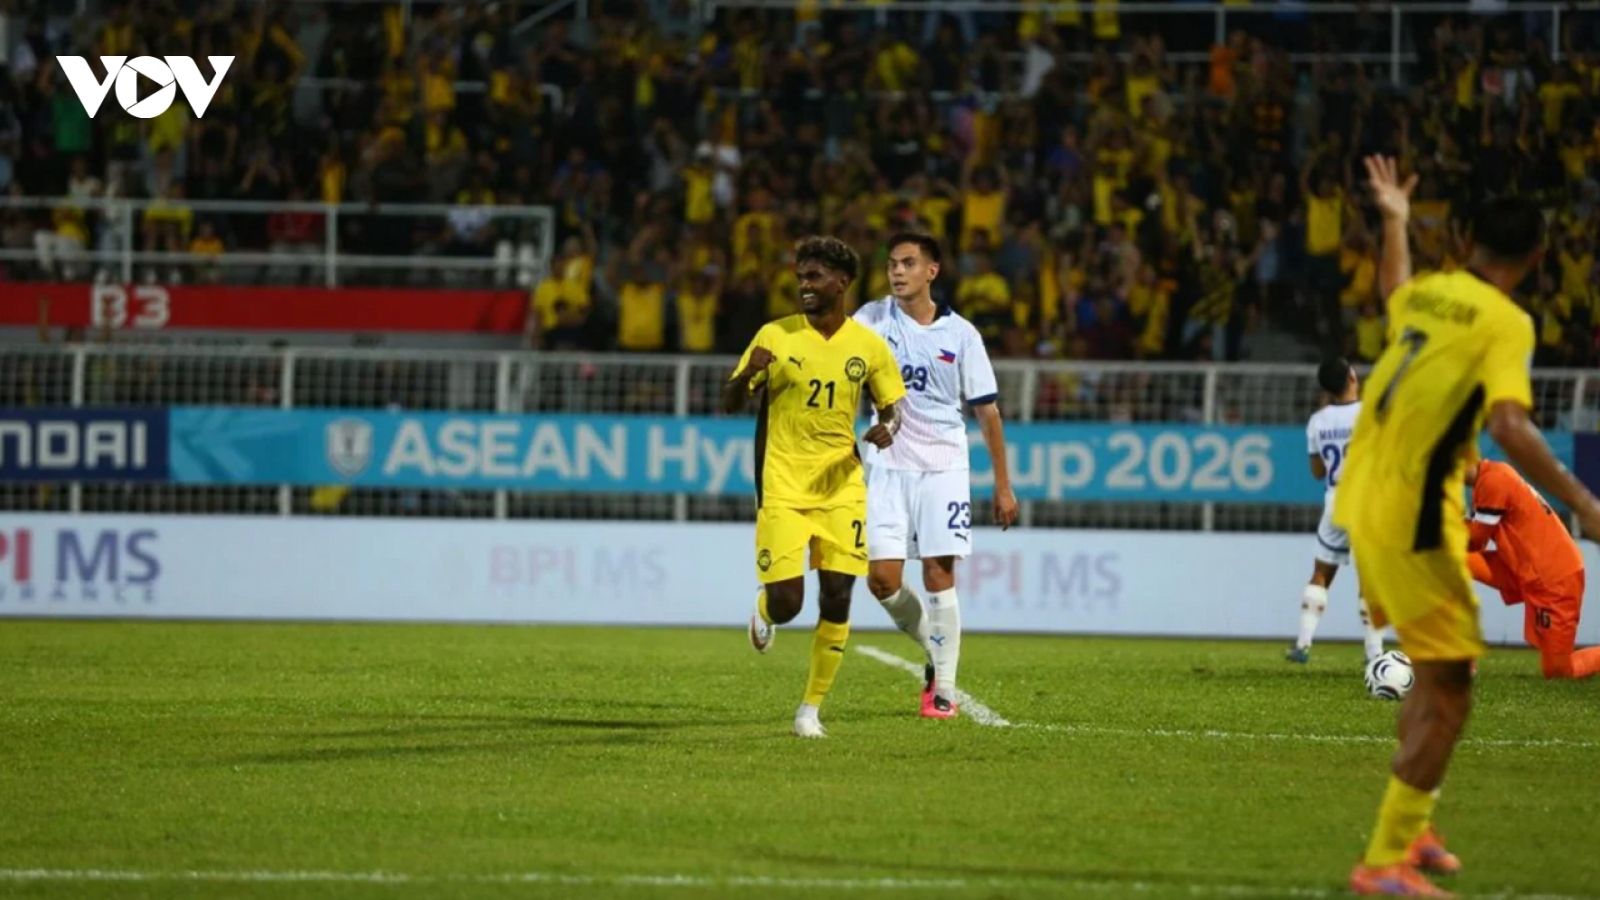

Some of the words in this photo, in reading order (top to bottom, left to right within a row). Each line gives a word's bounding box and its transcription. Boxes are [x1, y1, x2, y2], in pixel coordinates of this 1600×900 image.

[91, 284, 170, 330] B3
[806, 379, 836, 409] 21
[901, 364, 927, 391] 23
[383, 419, 627, 479] ASEAN
[1106, 432, 1273, 491] 2026
[851, 519, 867, 548] 2
[947, 501, 971, 529] 23
[56, 528, 160, 583] MS
[490, 545, 576, 586] BPI
[593, 546, 667, 587] MS
[957, 551, 1023, 595] PI
[1040, 552, 1121, 597] MS
